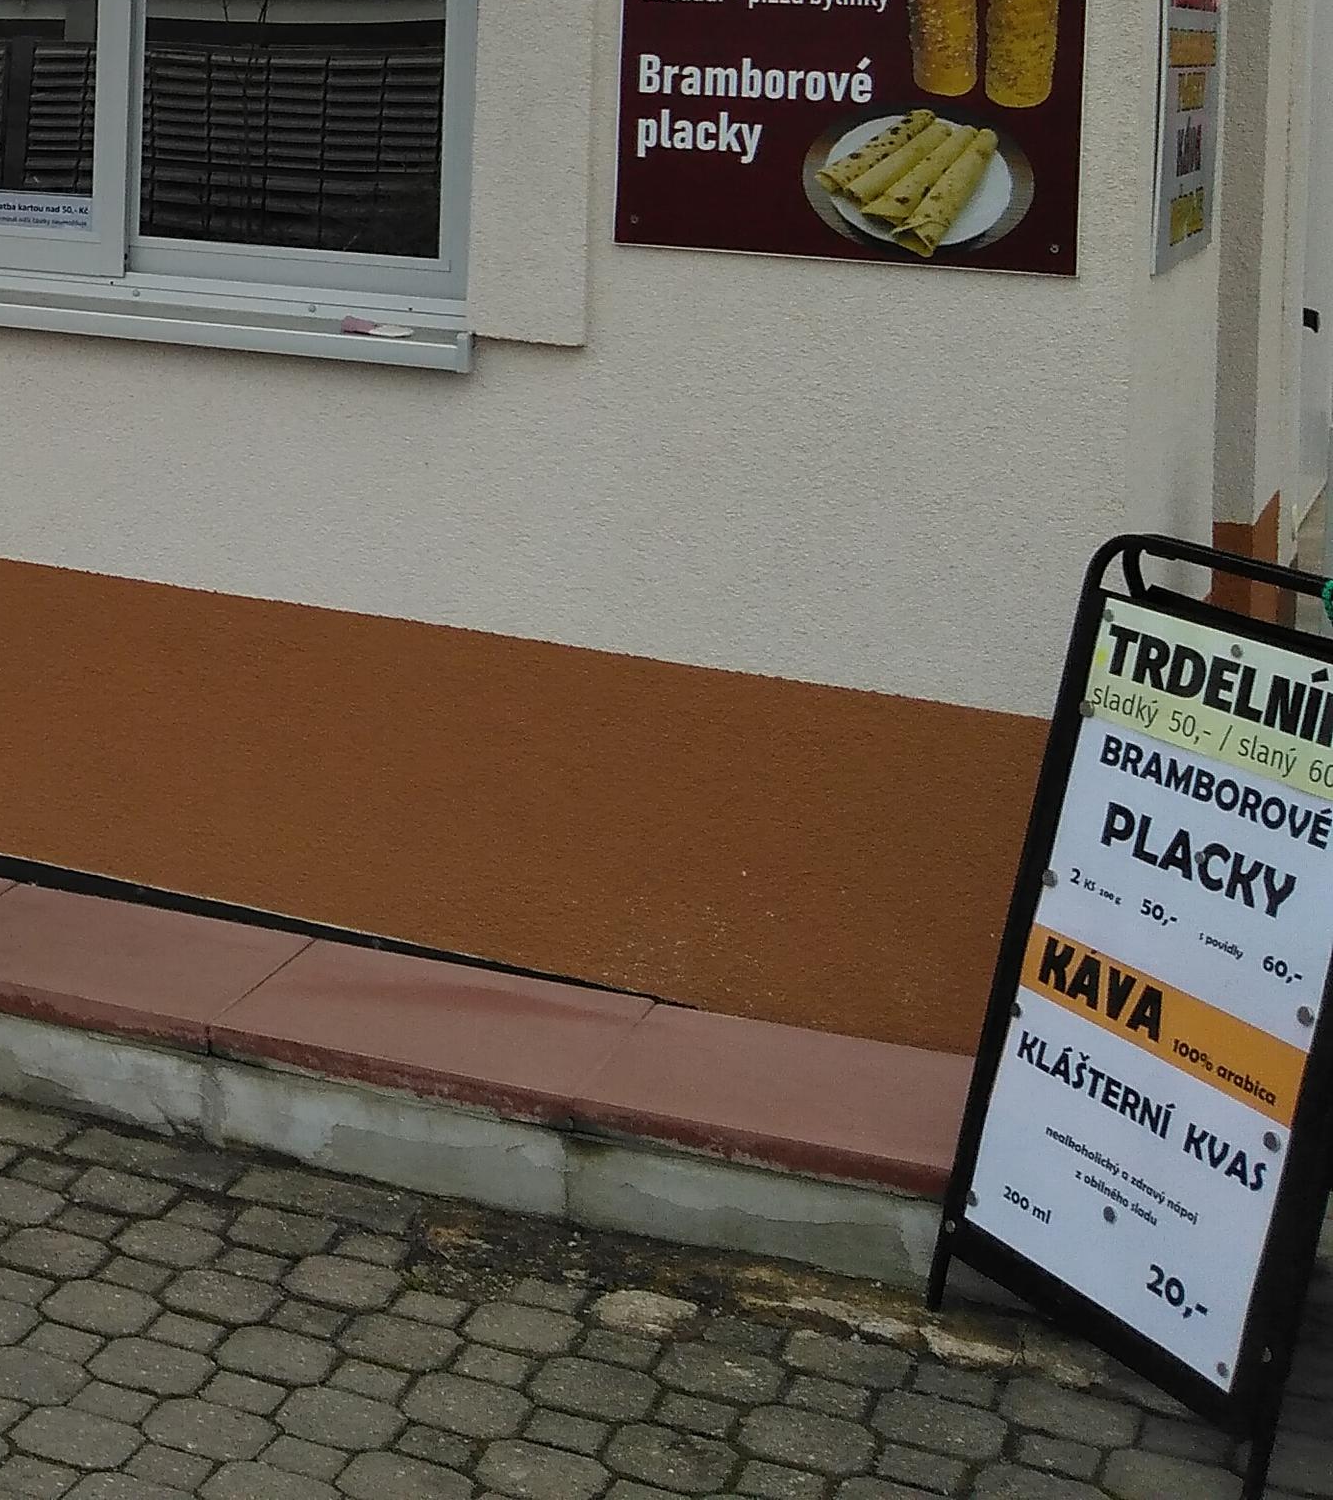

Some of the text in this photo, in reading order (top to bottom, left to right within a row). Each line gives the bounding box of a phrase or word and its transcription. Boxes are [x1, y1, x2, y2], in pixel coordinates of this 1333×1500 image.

[638, 54, 873, 103] Bramborové
[637, 110, 763, 163] placky
[18, 203, 44, 212] kartou
[45, 205, 60, 213] nad
[78, 206, 89, 214] Kč
[1093, 684, 1158, 728] sladký
[1169, 710, 1212, 746] 50,-
[1237, 735, 1298, 778] slaný
[1100, 734, 1332, 850] BRAMBOROVÉ
[1101, 801, 1298, 919] PLACKY
[1070, 868, 1081, 885] 2
[1140, 899, 1178, 926] 50,-
[1205, 934, 1244, 960] povidly
[1262, 956, 1303, 984] 60,-
[1038, 936, 1277, 1107] KÁVA 100% arabica
[1017, 1030, 1269, 1192] KLÁŠTERNÍ KVAS
[1002, 1185, 1052, 1225] 200 ml
[1045, 1126, 1120, 1176] nealkoholický
[1131, 1175, 1166, 1205] zdravý
[1167, 1198, 1199, 1226] nápoj
[1083, 1174, 1129, 1208] obilného
[1131, 1202, 1158, 1227] sladu
[1145, 1263, 1210, 1320] 20,-
